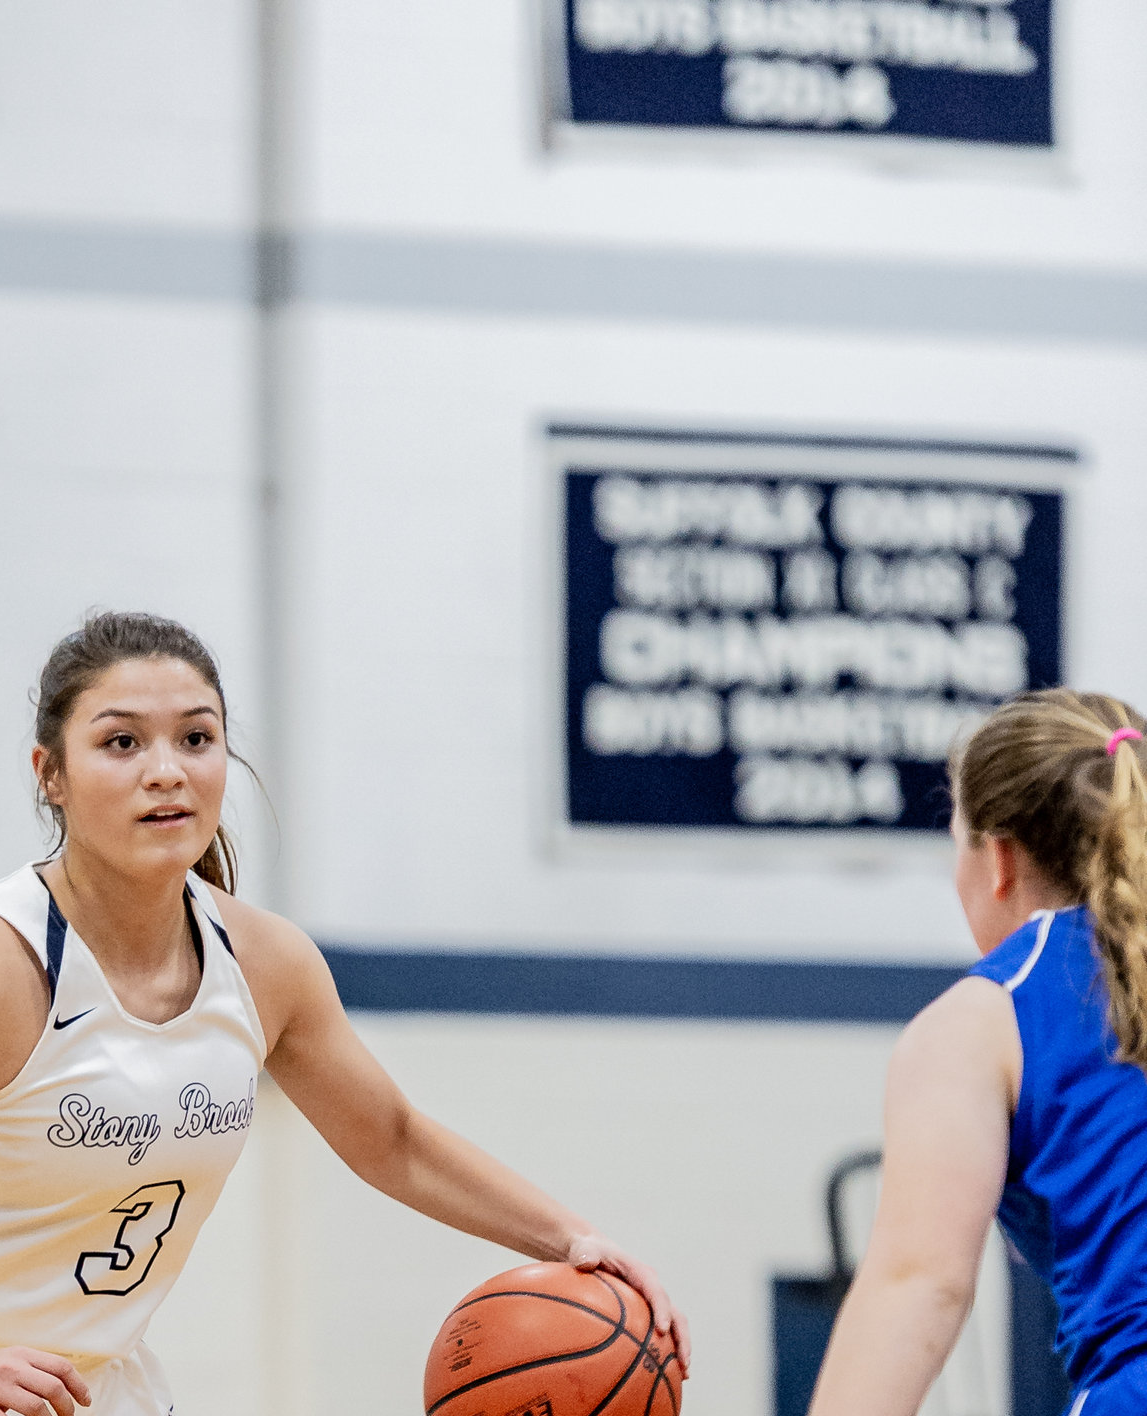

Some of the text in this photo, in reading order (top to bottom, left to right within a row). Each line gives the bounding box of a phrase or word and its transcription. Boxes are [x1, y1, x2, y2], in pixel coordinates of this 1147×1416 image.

[593, 476, 1033, 557] SUFFOLK COUNTY
[599, 609, 1028, 696] CHAMPIONS
[583, 683, 724, 756] BOYS
[47, 1093, 161, 1166] Stony
[74, 1179, 186, 1296] 3
